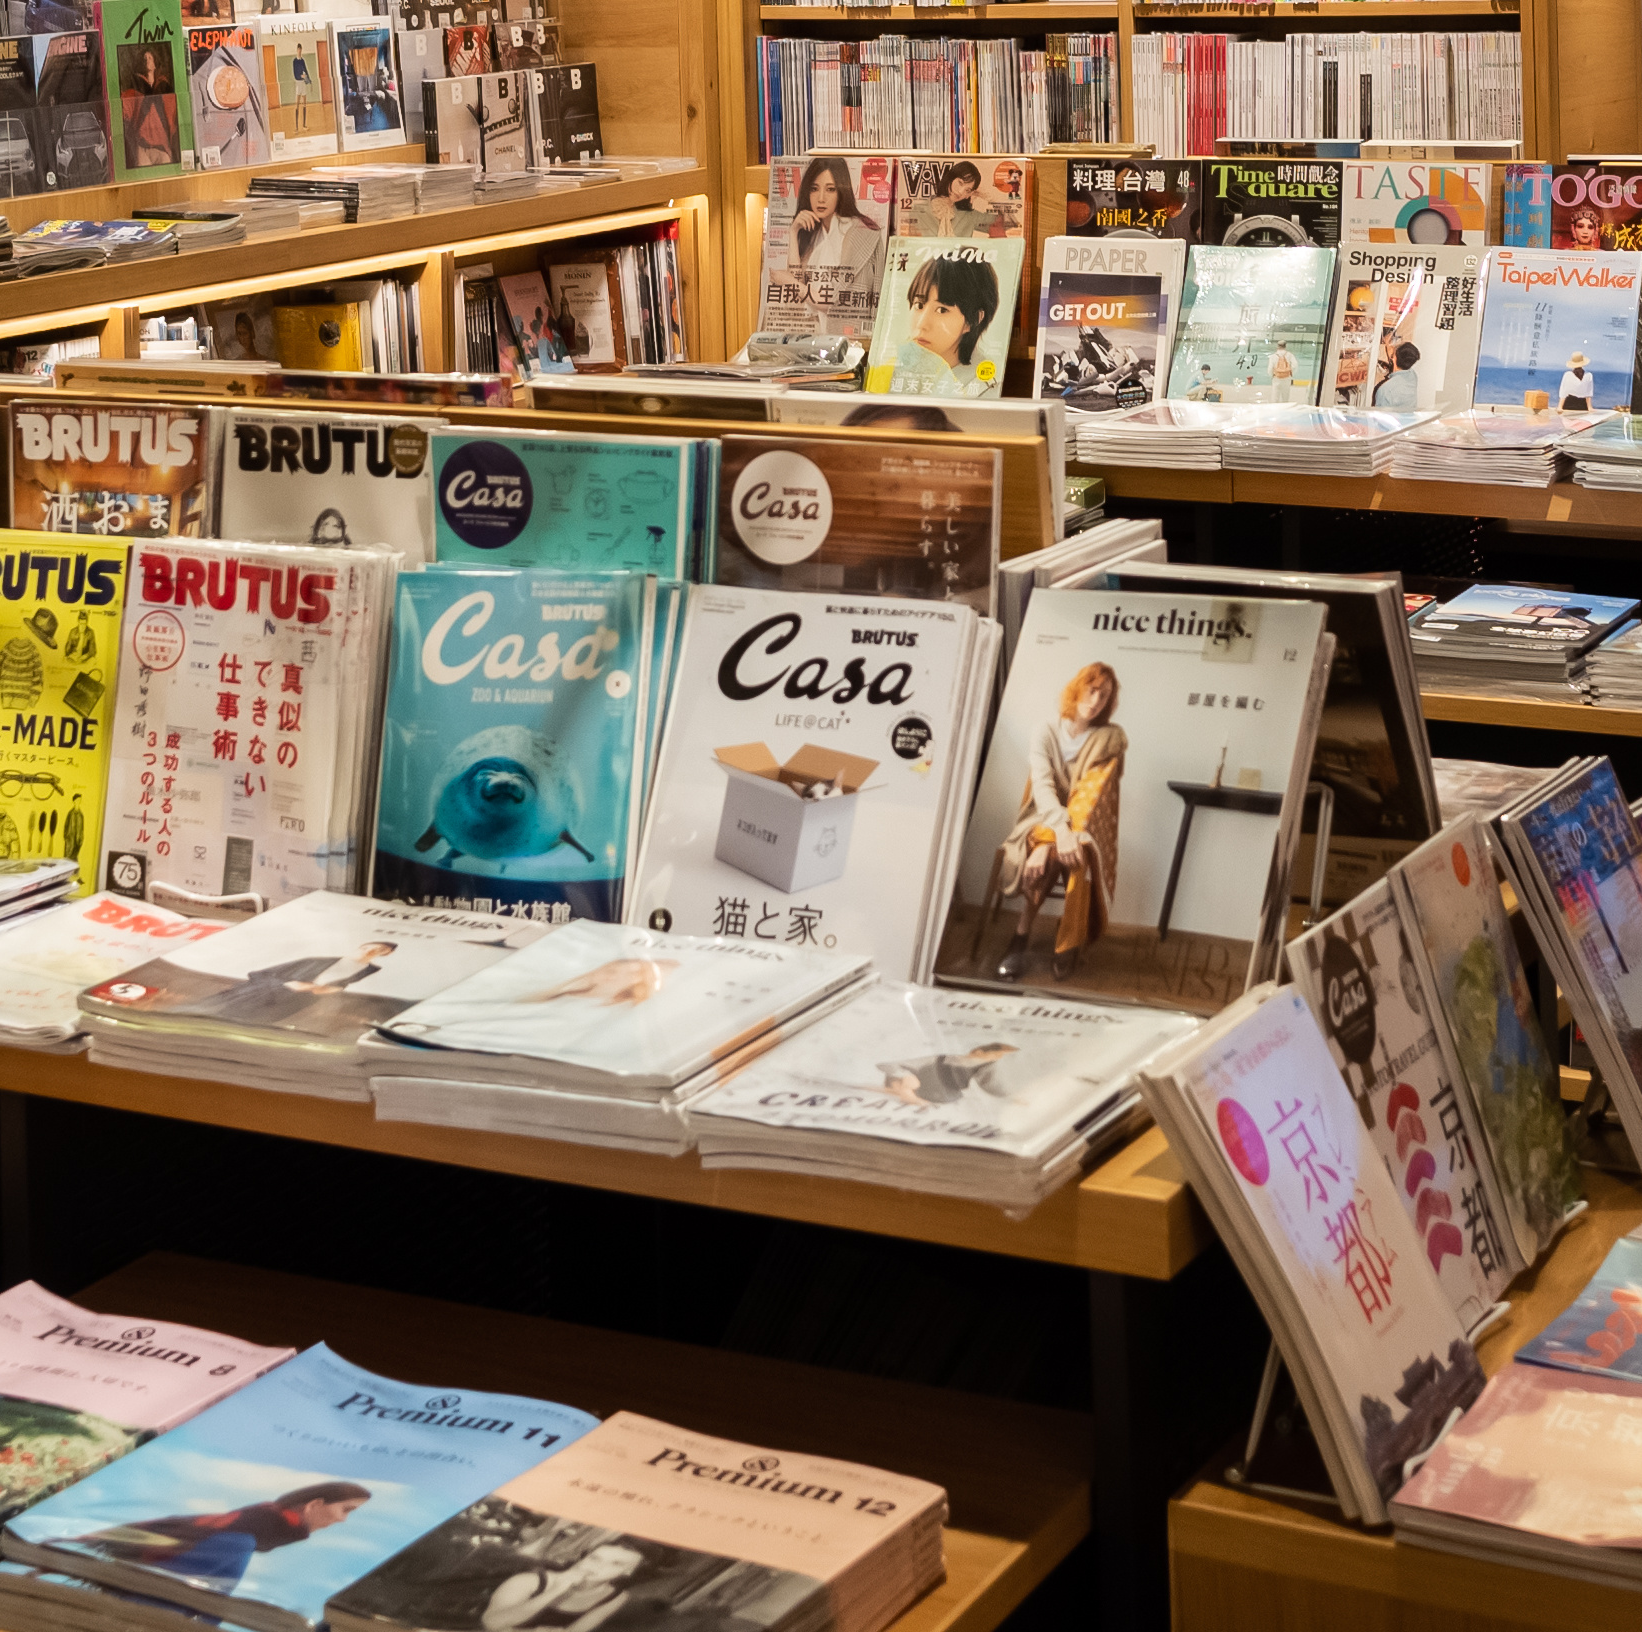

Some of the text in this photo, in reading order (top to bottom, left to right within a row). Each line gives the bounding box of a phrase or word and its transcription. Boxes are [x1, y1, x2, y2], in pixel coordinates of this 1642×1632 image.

[269, 20, 319, 37] KINFOLK
[1177, 170, 1190, 189] 48
[1211, 164, 1275, 198] Time
[900, 198, 913, 211] 12
[1065, 246, 1148, 274] PPAPER
[1348, 250, 1438, 271] Shopping
[766, 284, 835, 305] 自我人生
[1049, 302, 1127, 321] GET OUT
[1460, 276, 1478, 317] 好生活
[17, 411, 199, 467] BRUTUS
[445, 469, 526, 511] Casa
[738, 481, 821, 523] Casa
[139, 552, 337, 623] BRUTUS
[541, 605, 607, 621] BRUTUS
[1092, 608, 1150, 635] nice
[420, 590, 607, 686] Casa
[851, 628, 919, 647] BRUTUS
[716, 611, 915, 707] Casa
[212, 652, 243, 761] 仕事術
[276, 662, 304, 769] 真似の
[472, 687, 492, 703] ZOO
[502, 689, 555, 705] AQUARIUM
[1187, 692, 1266, 712] 部屋を編む
[244, 659, 273, 798] できない
[156, 733, 182, 857] 成功する人の
[712, 895, 838, 948] 猫と家。
[32, 1323, 232, 1377] Premium 8
[333, 1390, 515, 1438] Premium
[643, 1445, 897, 1518] Premium 12
